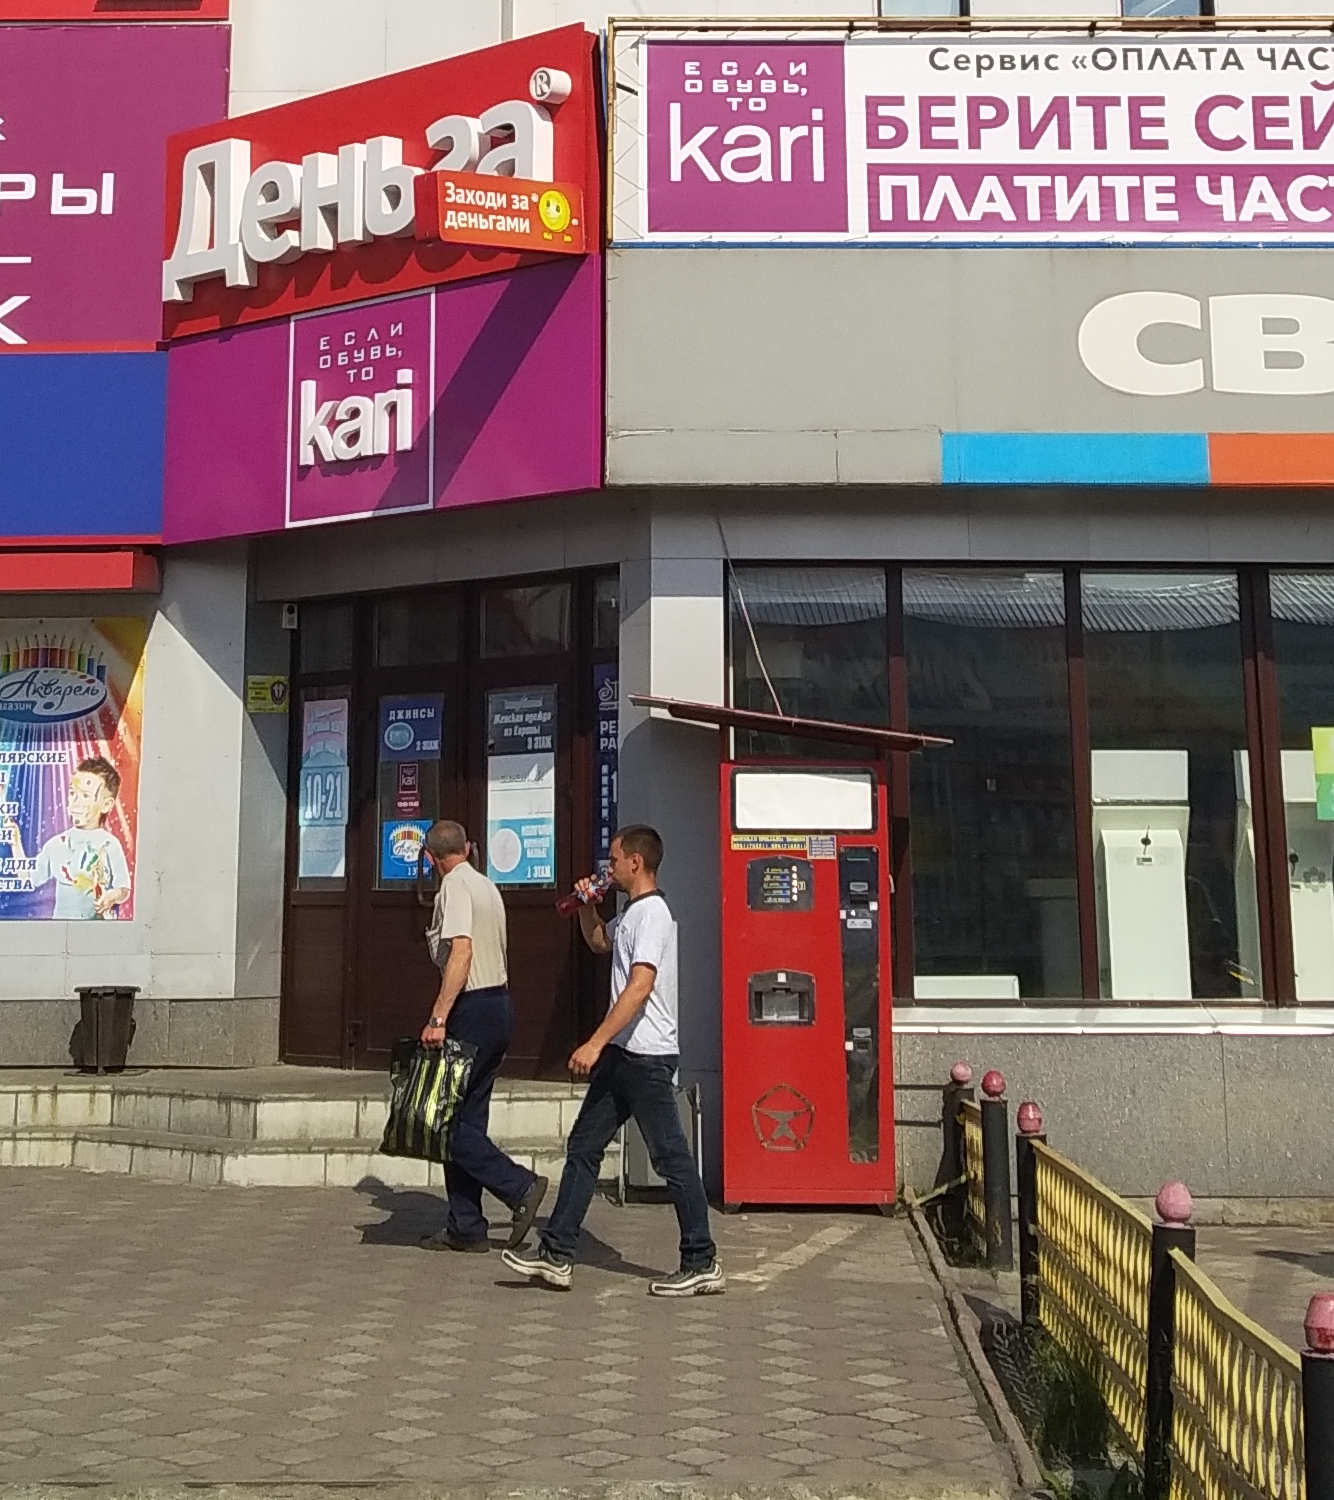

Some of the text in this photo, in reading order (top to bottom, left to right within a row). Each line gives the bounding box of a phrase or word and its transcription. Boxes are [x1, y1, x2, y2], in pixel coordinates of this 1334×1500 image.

[685, 62, 807, 76] ЕСЛИ
[928, 47, 1060, 78] Сервис
[726, 97, 767, 112] ТО
[867, 94, 1174, 151] БЕРИТЕ
[670, 102, 825, 183] kari
[444, 181, 506, 210] Заходи
[878, 174, 1179, 223] ПЛАТИТЕ
[444, 209, 531, 234] деньгами
[319, 322, 404, 350] ЕСЛИ
[346, 366, 374, 383] ТО
[298, 368, 413, 466] kari
[0, 670, 100, 710] Акварель
[388, 707, 435, 721] ДЖИНСЫ
[3, 859, 37, 872] ДЛЯ
